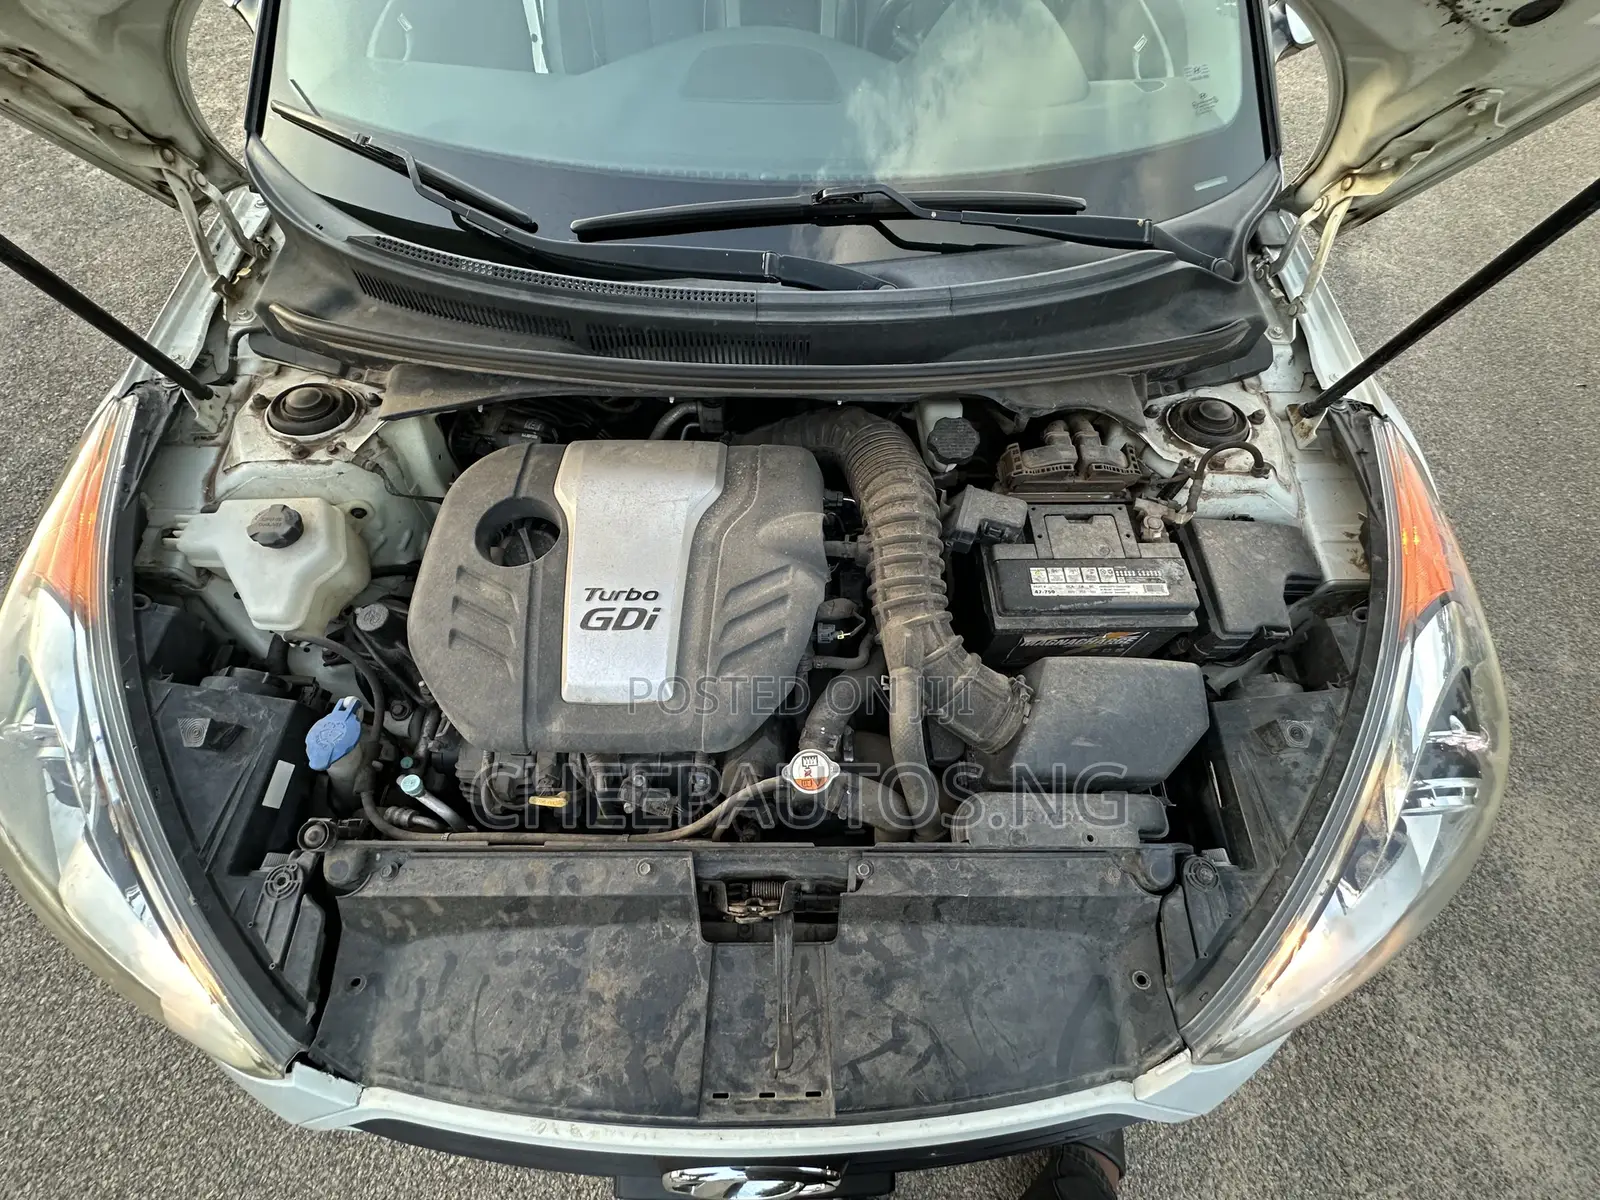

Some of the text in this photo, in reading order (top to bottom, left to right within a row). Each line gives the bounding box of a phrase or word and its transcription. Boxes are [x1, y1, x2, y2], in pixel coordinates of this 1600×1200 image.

[584, 587, 660, 602] Turbo
[579, 606, 662, 631] GDi
[1020, 634, 1140, 647] MAGNACHARGE
